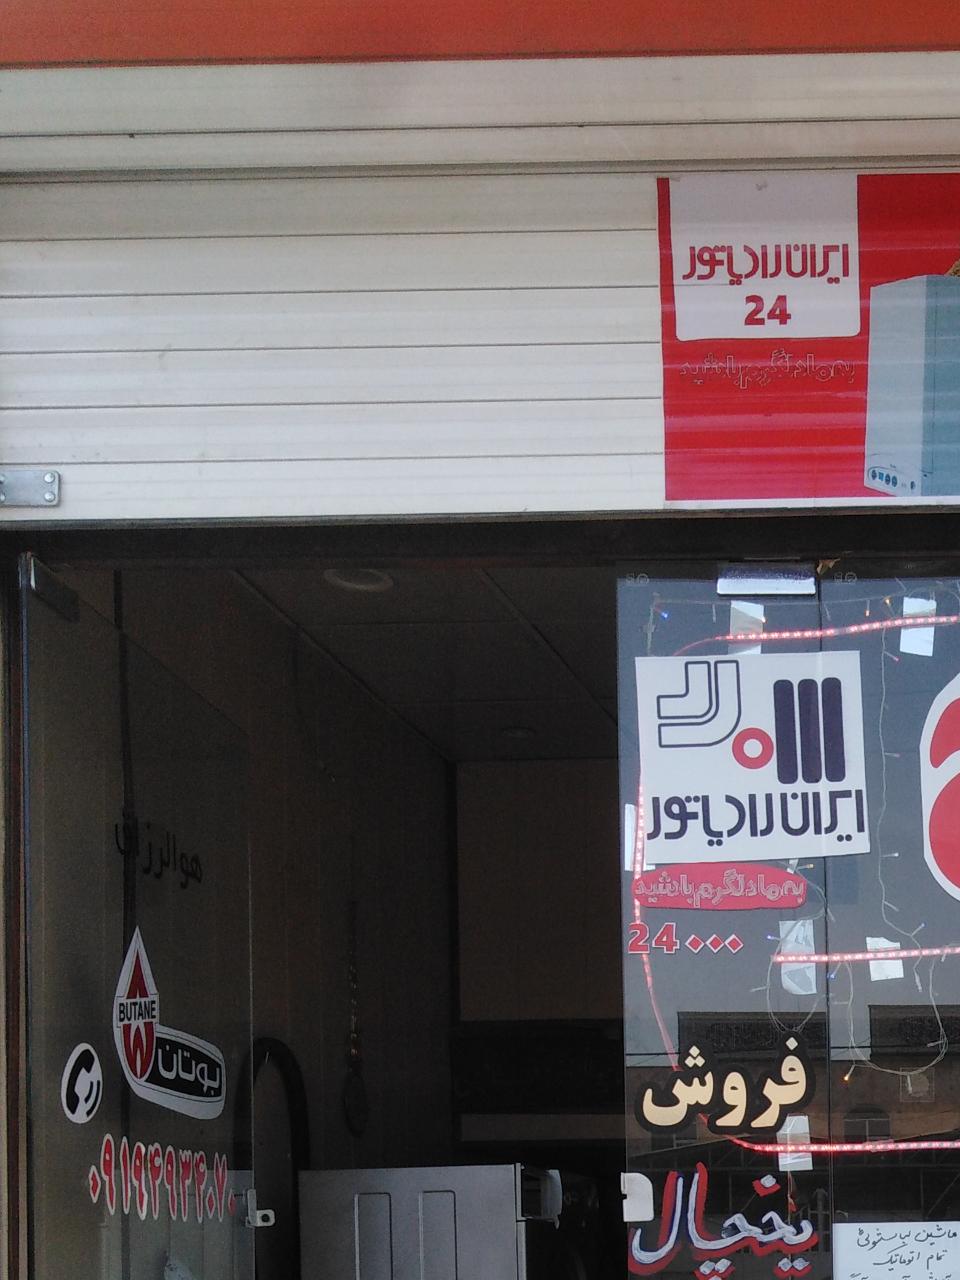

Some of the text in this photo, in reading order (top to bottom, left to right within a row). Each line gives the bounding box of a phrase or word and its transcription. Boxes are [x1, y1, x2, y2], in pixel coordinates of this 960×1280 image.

[682, 244, 849, 286] ایران رادیاتور
[744, 295, 792, 325] 24
[647, 789, 865, 847] ایران رادیاتور
[119, 1001, 156, 1022] BUTANE
[158, 1045, 220, 1095] بوتان
[642, 1036, 807, 1128] فروش
[915, 1225, 957, 1245] ماشین
[873, 1241, 947, 1271] تمام اتوماتیک
